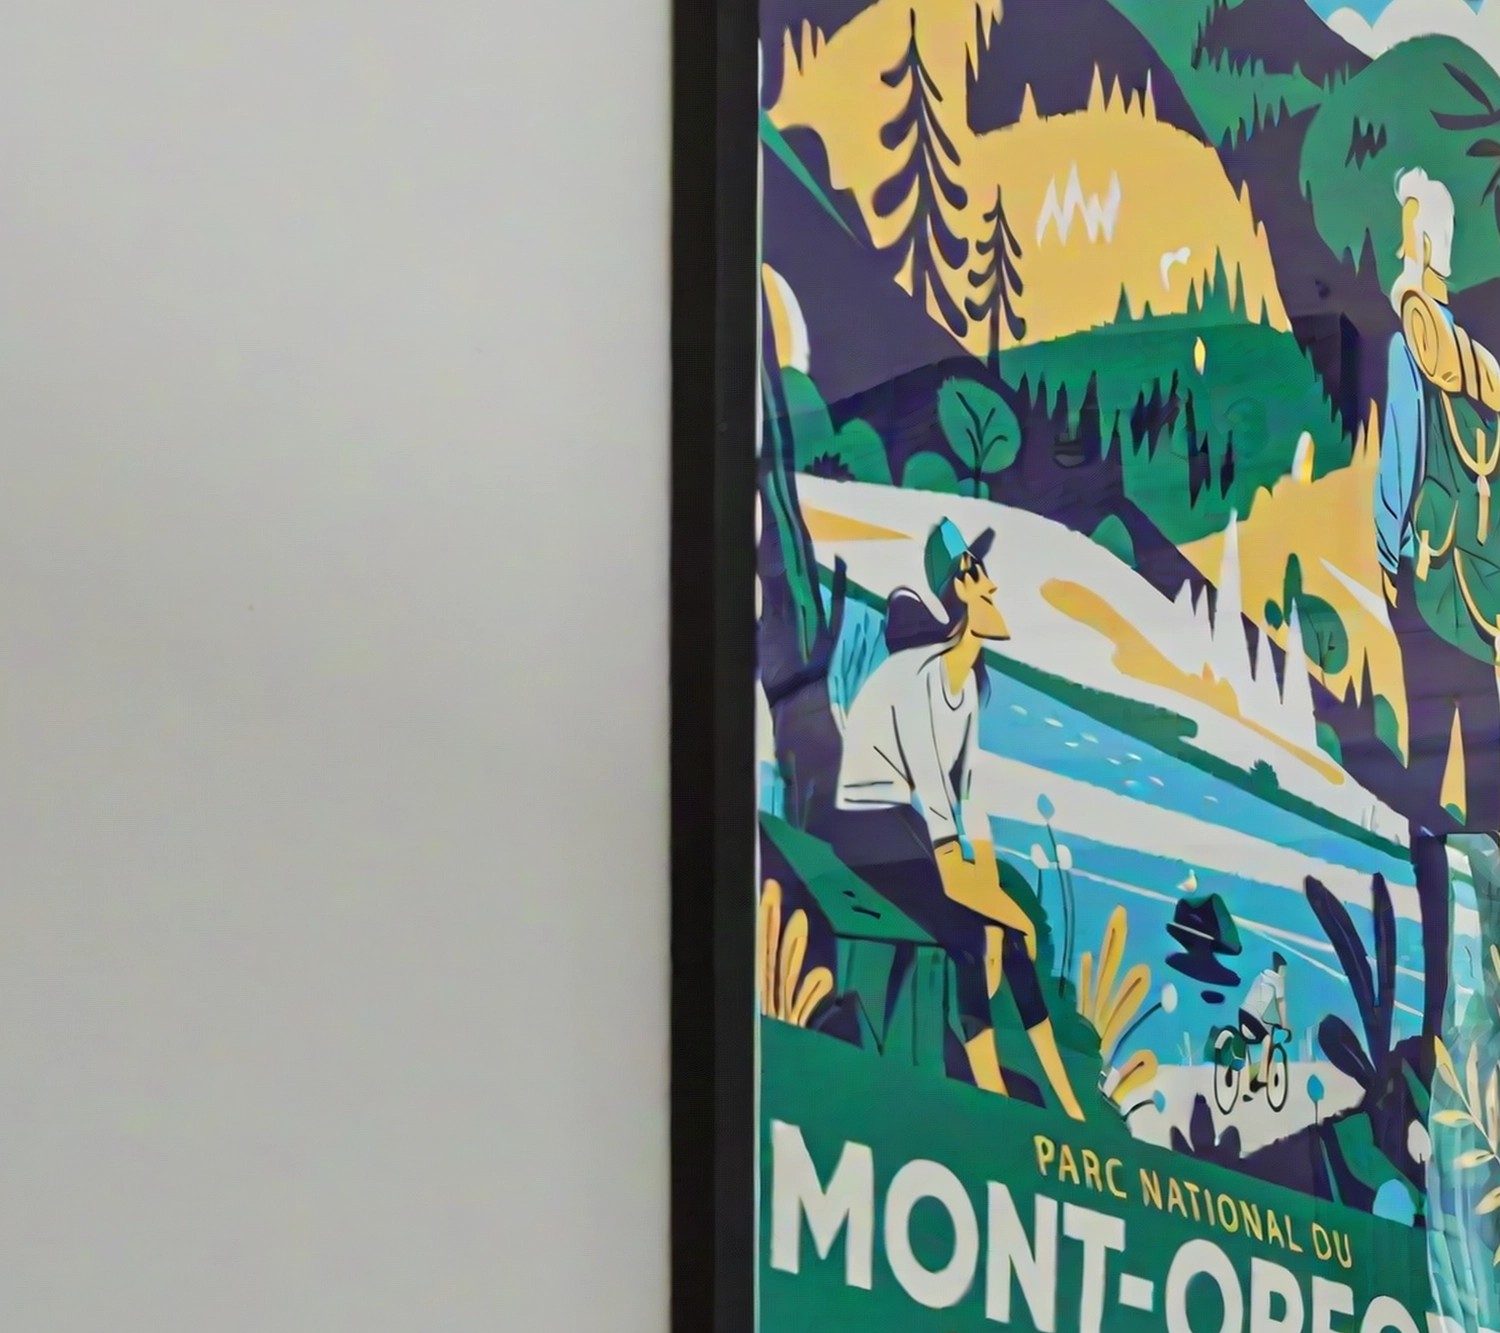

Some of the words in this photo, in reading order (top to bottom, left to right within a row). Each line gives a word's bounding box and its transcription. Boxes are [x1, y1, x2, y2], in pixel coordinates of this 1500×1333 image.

[1033, 1134, 1127, 1199] PARC
[1139, 1168, 1304, 1252] NATIONAL
[1311, 1222, 1353, 1268] DU
